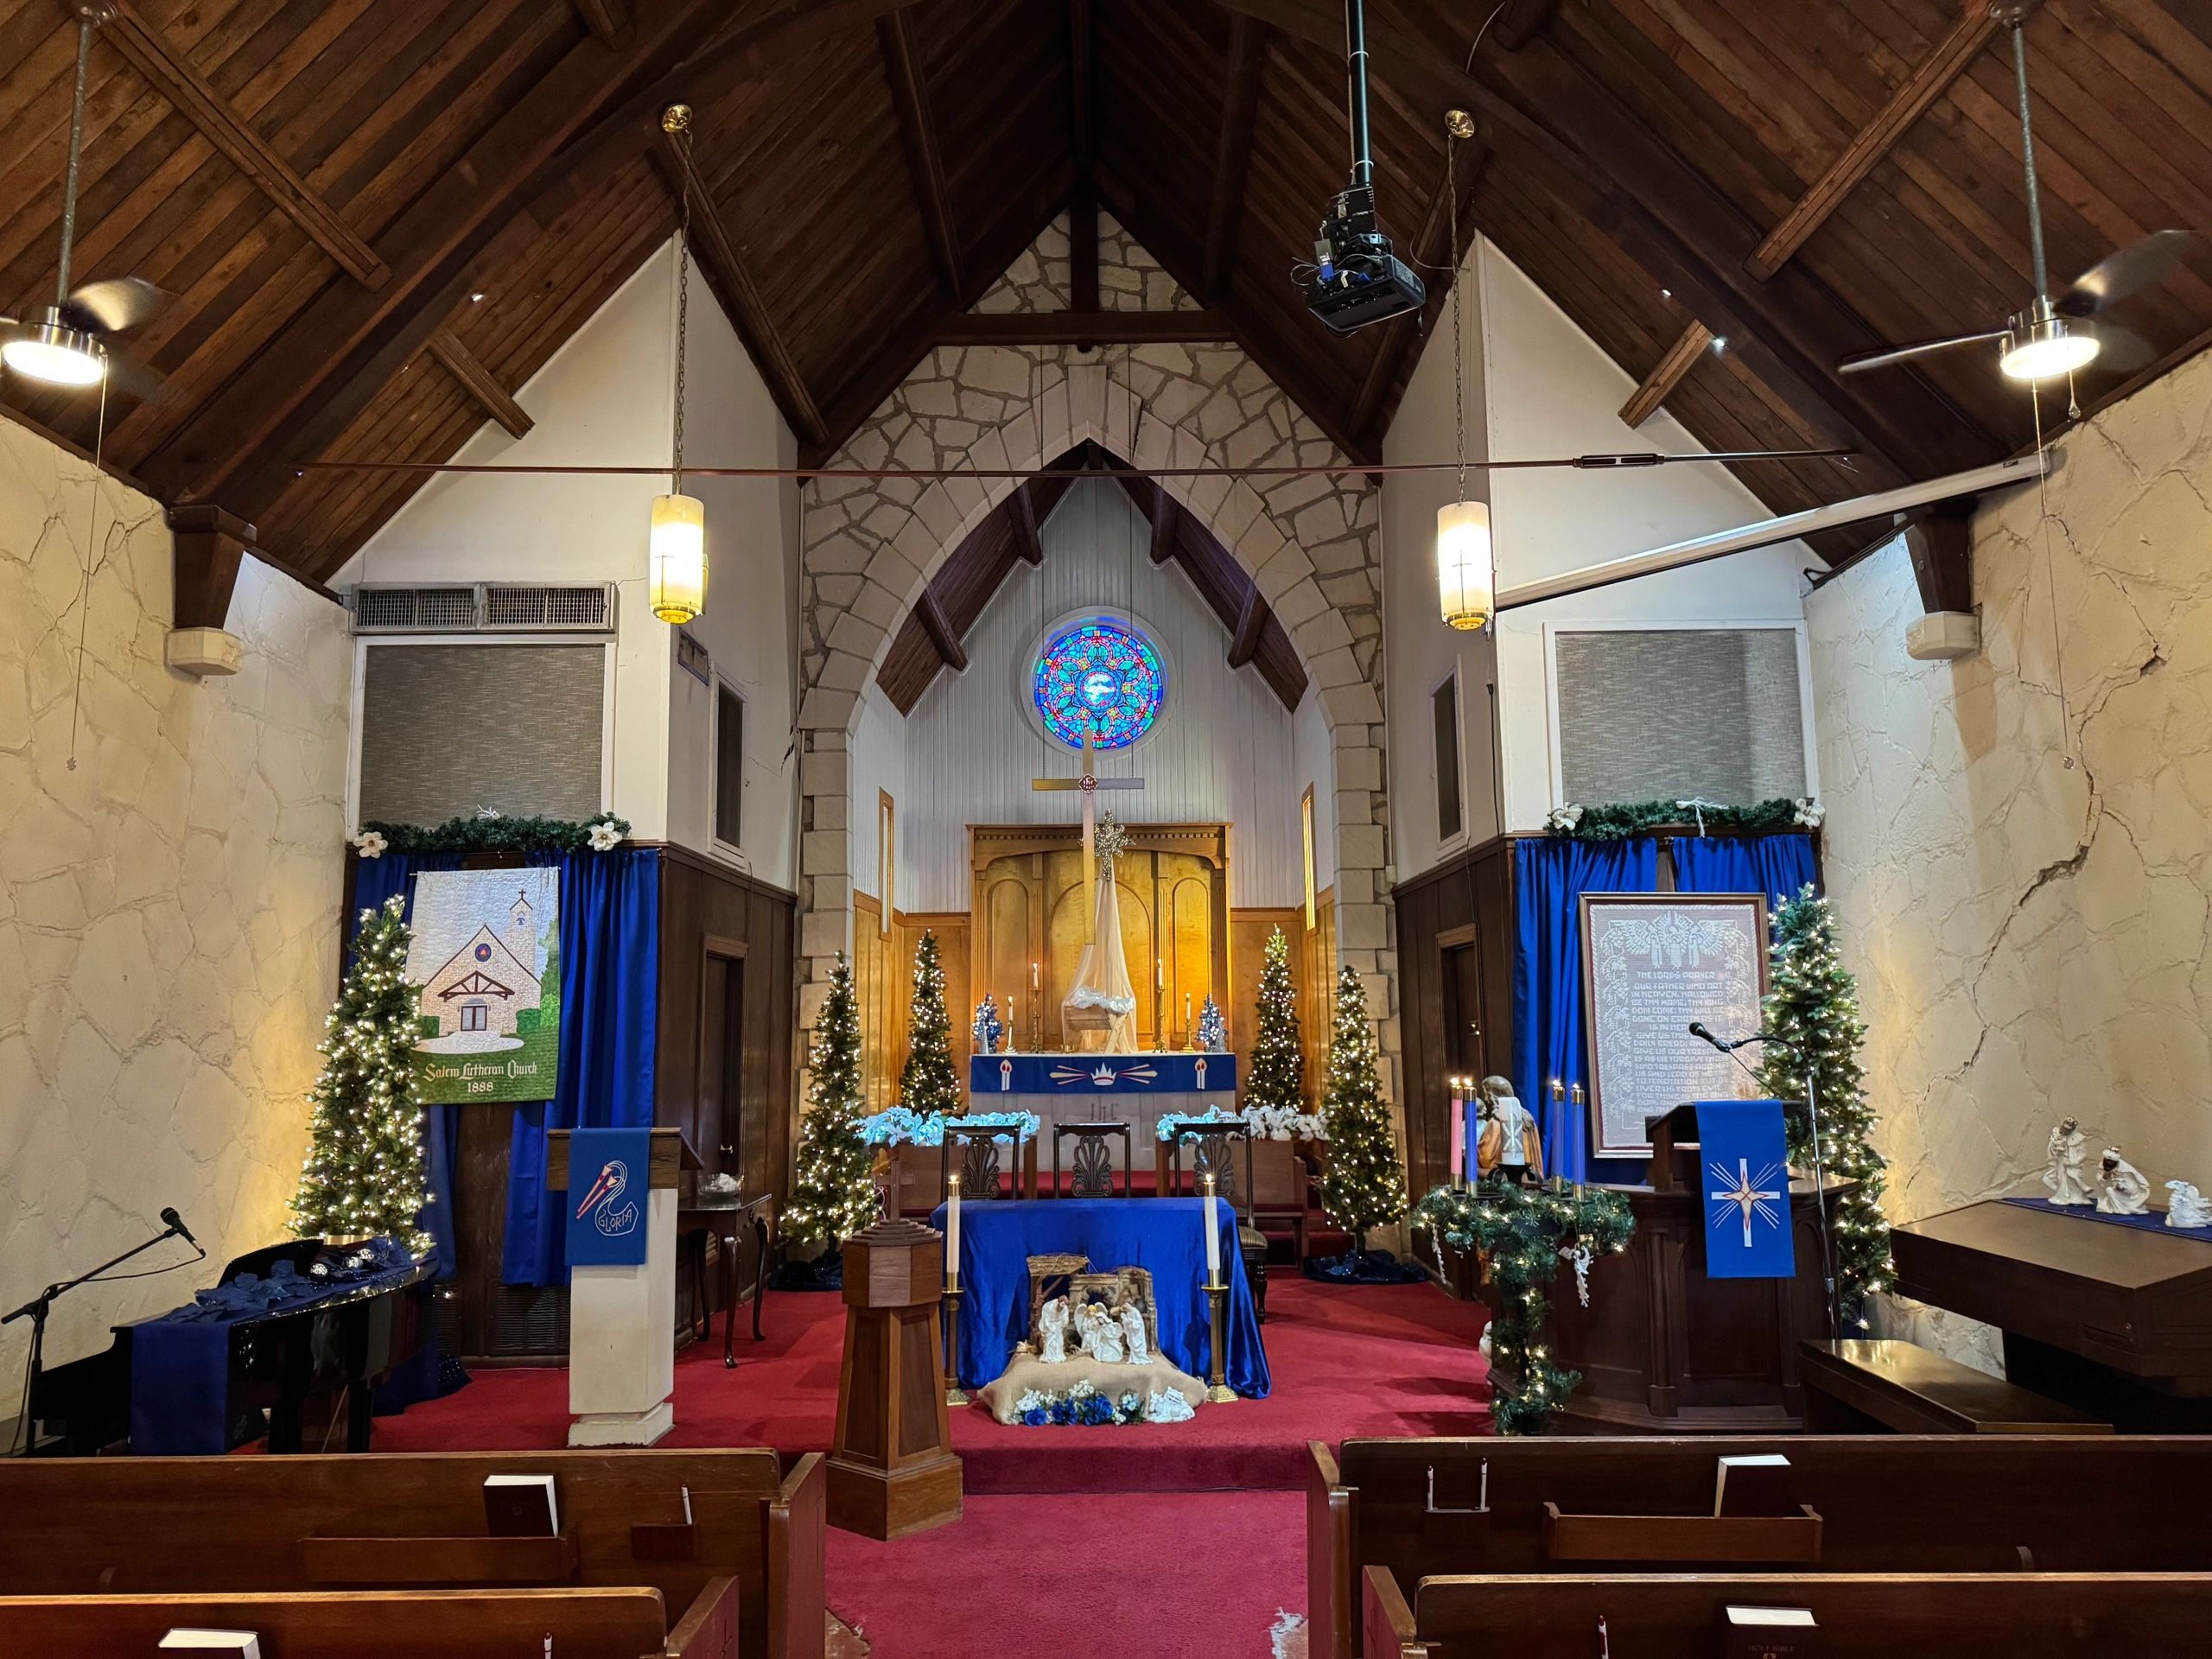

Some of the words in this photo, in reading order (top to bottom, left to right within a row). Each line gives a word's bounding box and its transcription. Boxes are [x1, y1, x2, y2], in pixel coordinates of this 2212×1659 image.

[1637, 971, 1651, 980] THE
[1682, 971, 1715, 980] PRAYER
[422, 1063, 460, 1083] Salem
[458, 1062, 505, 1081] Lutheran
[507, 1059, 537, 1079] Church
[467, 1082, 493, 1093] 1888
[598, 1209, 632, 1232] GLORIA
